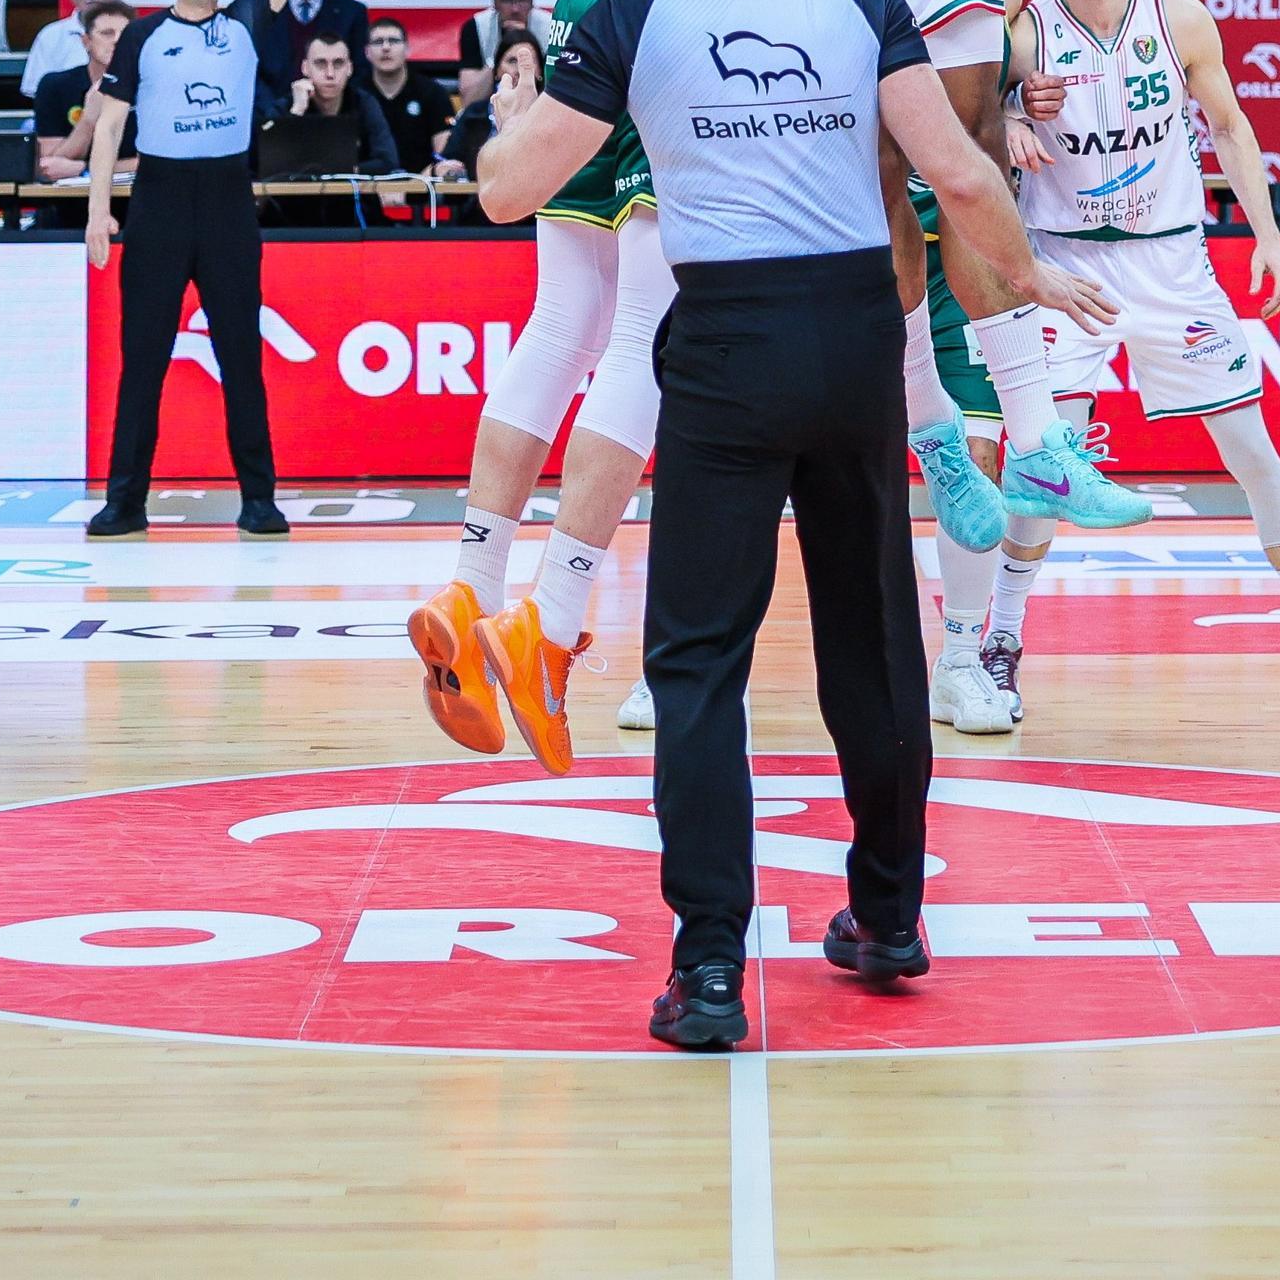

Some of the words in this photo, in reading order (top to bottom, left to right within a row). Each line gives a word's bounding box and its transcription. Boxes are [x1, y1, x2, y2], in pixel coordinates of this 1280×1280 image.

[1056, 50, 1082, 65] 4F
[1125, 69, 1171, 112] 35
[173, 120, 203, 134] Bank
[205, 115, 238, 131] Pekao
[691, 113, 769, 140] Bank
[773, 109, 857, 137] Pekao
[1058, 113, 1174, 156] BAZALT
[1182, 336, 1233, 360] aquapark
[1228, 353, 1248, 372] 4F
